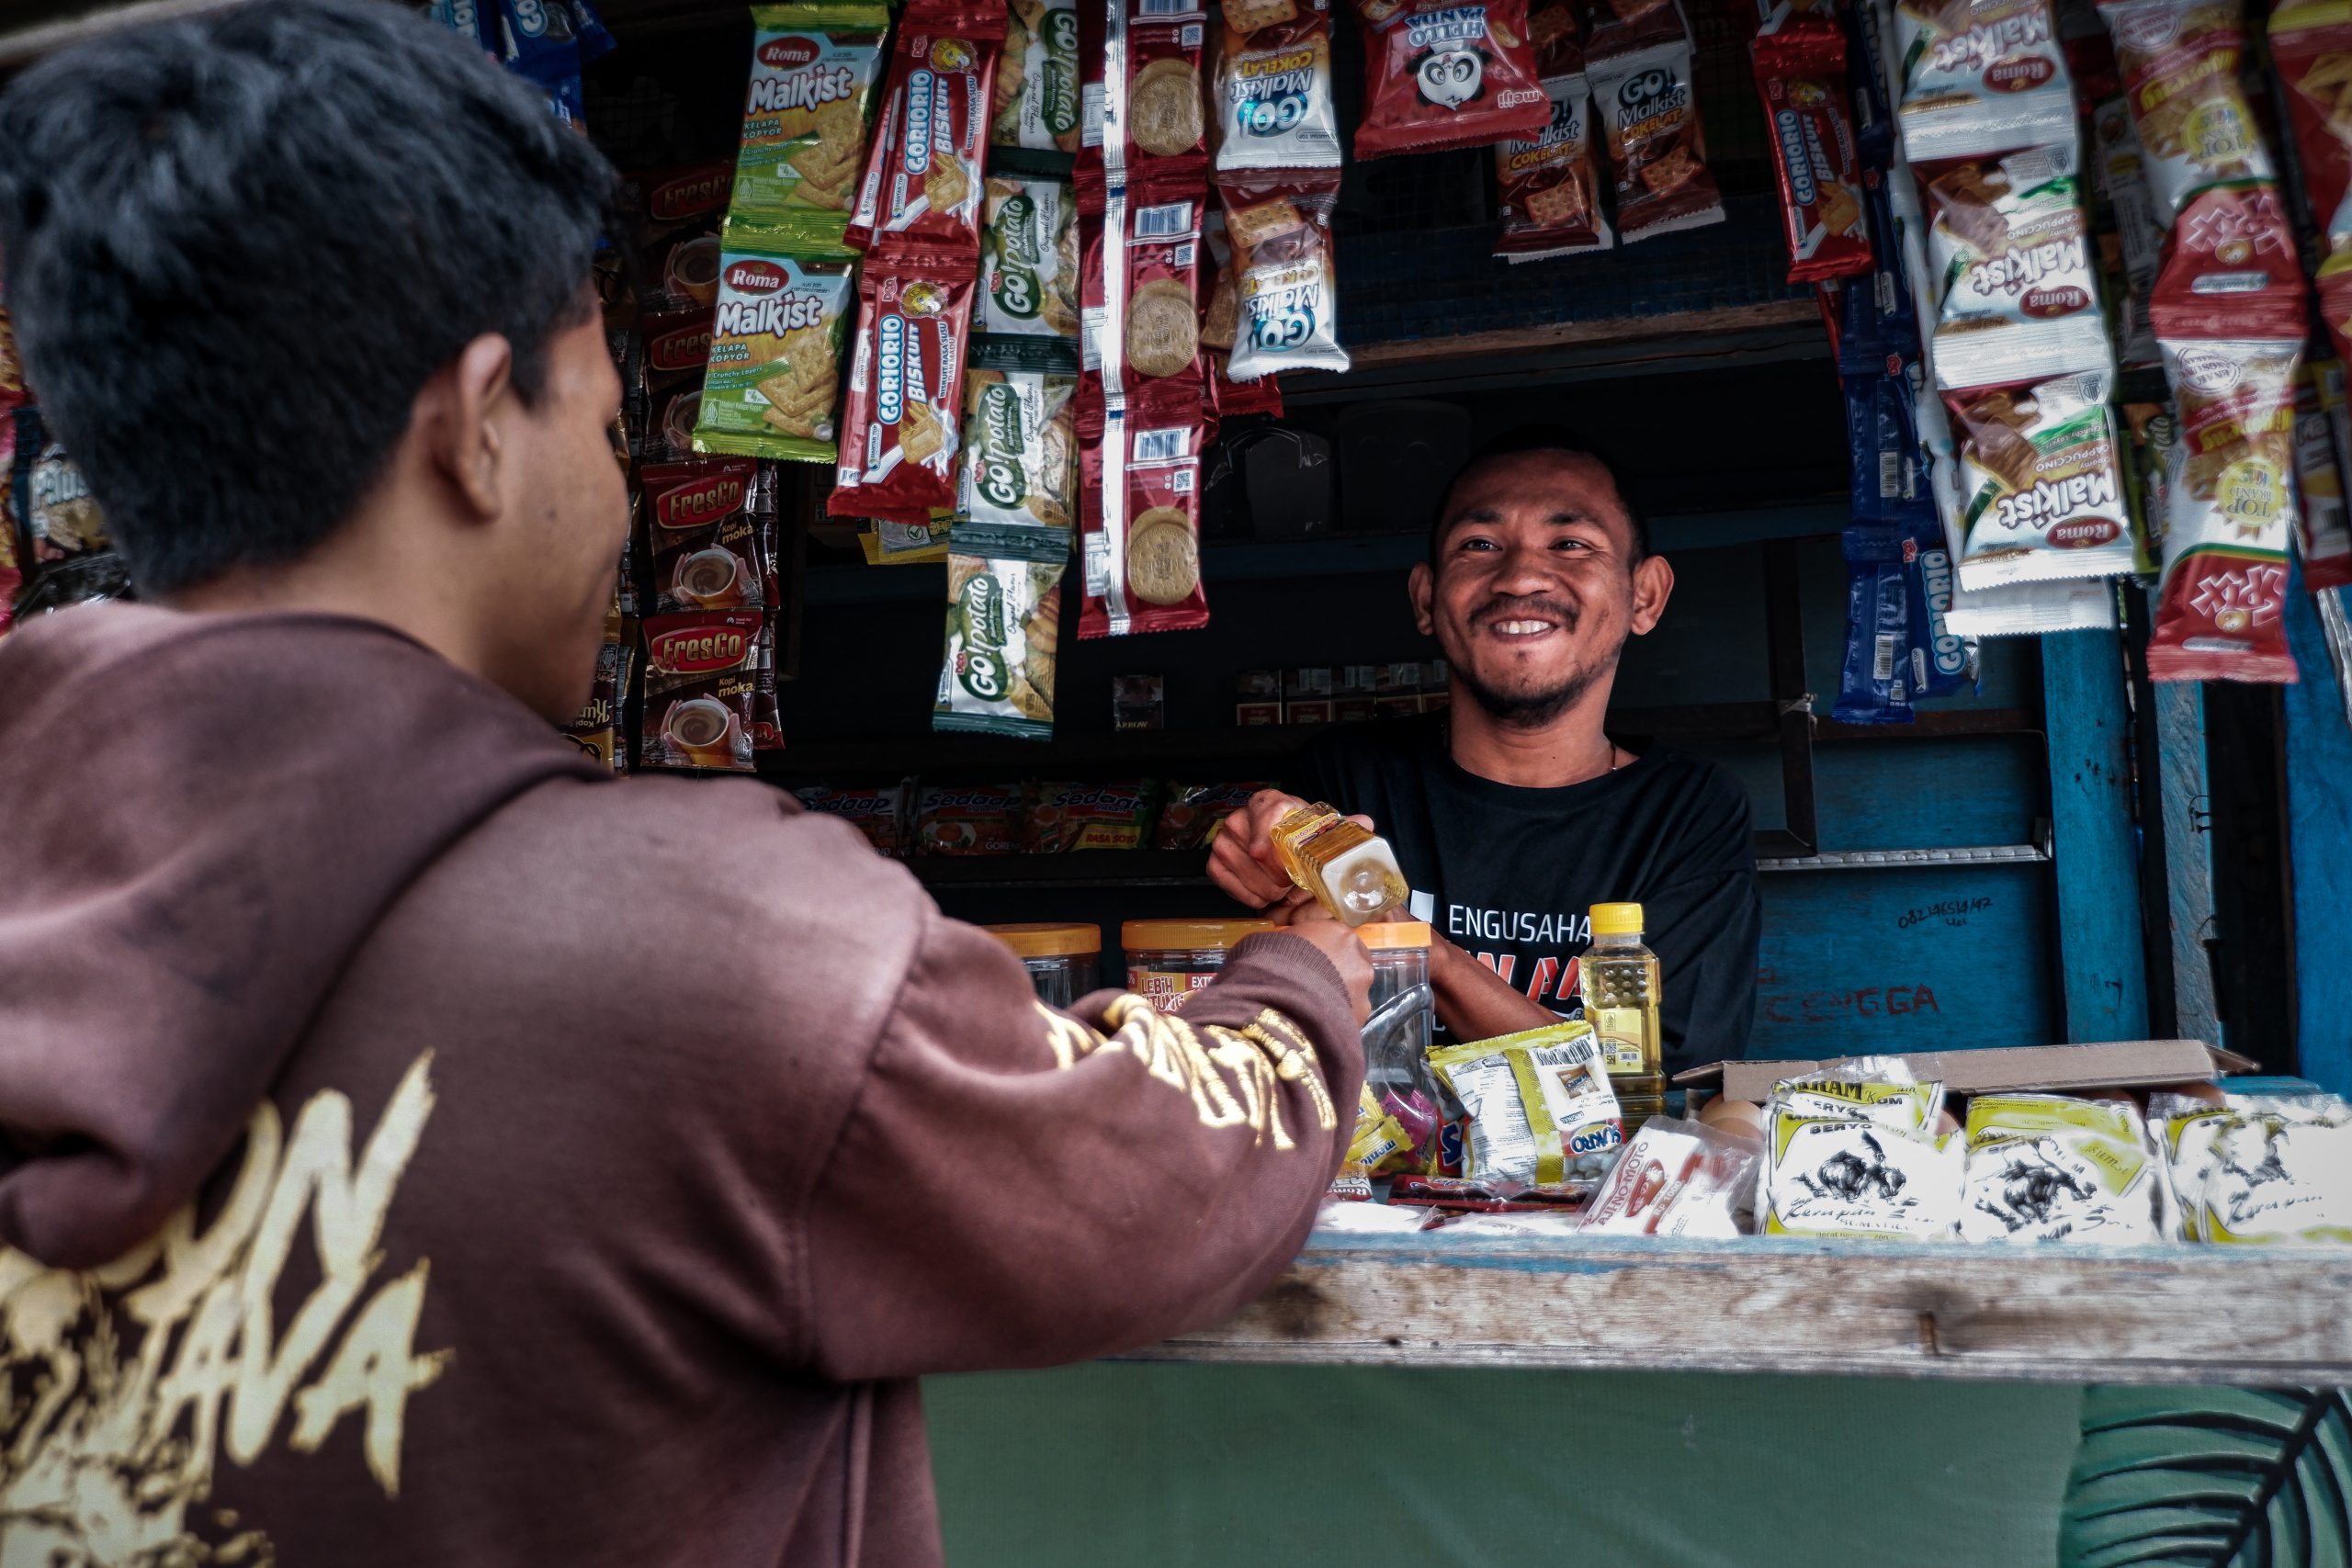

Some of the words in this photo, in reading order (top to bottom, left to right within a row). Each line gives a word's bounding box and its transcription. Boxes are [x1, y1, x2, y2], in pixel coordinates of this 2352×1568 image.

[1404, 6, 1486, 29] PANDA
[1408, 20, 1486, 47] HELLO
[1933, 9, 2050, 73] Malkist
[765, 47, 811, 62] Roma
[1243, 51, 1314, 76] COKELAT
[1992, 62, 2045, 82] Roma
[747, 65, 854, 115] Malkist
[967, 77, 976, 96] SUSU
[1231, 68, 1313, 104] Malkist
[1497, 89, 1540, 109] meiji
[1622, 66, 1675, 106] GO!
[934, 78, 955, 154] BISKUIT
[976, 91, 984, 115] MADU
[1240, 96, 1302, 137] GO!
[1618, 89, 1686, 130] Malkist
[743, 119, 780, 130] KELAPA
[743, 128, 782, 139] KOPYOR
[906, 70, 933, 173] GORIORIO
[1620, 108, 1682, 144] COKELAT
[1510, 141, 1574, 170] COKELAT
[1776, 110, 1815, 205] GORIORIO
[1802, 114, 1835, 182] BISKUIT
[896, 175, 904, 186] TOP
[1004, 198, 1035, 269] potato
[1039, 220, 1052, 253] Original
[2007, 212, 2079, 241] CAPPUCCINO
[732, 269, 780, 288] Roma
[1971, 236, 2086, 296] Malkist
[2029, 290, 2080, 308] Roma
[714, 292, 824, 339] Malkist
[663, 332, 711, 361] Fres
[939, 322, 947, 344] SUSU
[710, 353, 750, 363] KOPYOR
[711, 344, 747, 354] KELAPA
[713, 369, 741, 378] Crunchy
[741, 367, 763, 377] Layers
[879, 317, 905, 423] GORIORIO
[907, 323, 927, 403] BISKUIT
[985, 388, 1019, 459] potato
[1024, 412, 1037, 443] Original
[2035, 444, 2109, 472] CAPPUCCINO
[671, 479, 741, 521] FresCo
[1997, 468, 2115, 530] Malkist
[2226, 498, 2271, 518] TOP
[721, 522, 738, 534] Kopi
[721, 524, 754, 545] moka
[2057, 523, 2109, 538] Roma
[967, 577, 1002, 650] potato
[1007, 602, 1019, 634] Original
[662, 632, 741, 660] FresCo
[718, 675, 737, 687] Kopi
[718, 680, 754, 698] moka
[575, 718, 594, 728] Kopi
[804, 793, 890, 813] Sedaap
[923, 791, 1022, 809] Sedaap
[1052, 789, 1148, 810] Sedaap
[985, 841, 1021, 852] GOREN
[1085, 833, 1110, 844] RASA
[1143, 993, 1186, 1011] TUNG
[1570, 1122, 1623, 1155] SUKRO
[1360, 1139, 1397, 1166] mento
[1663, 1180, 1683, 1205] 1000
